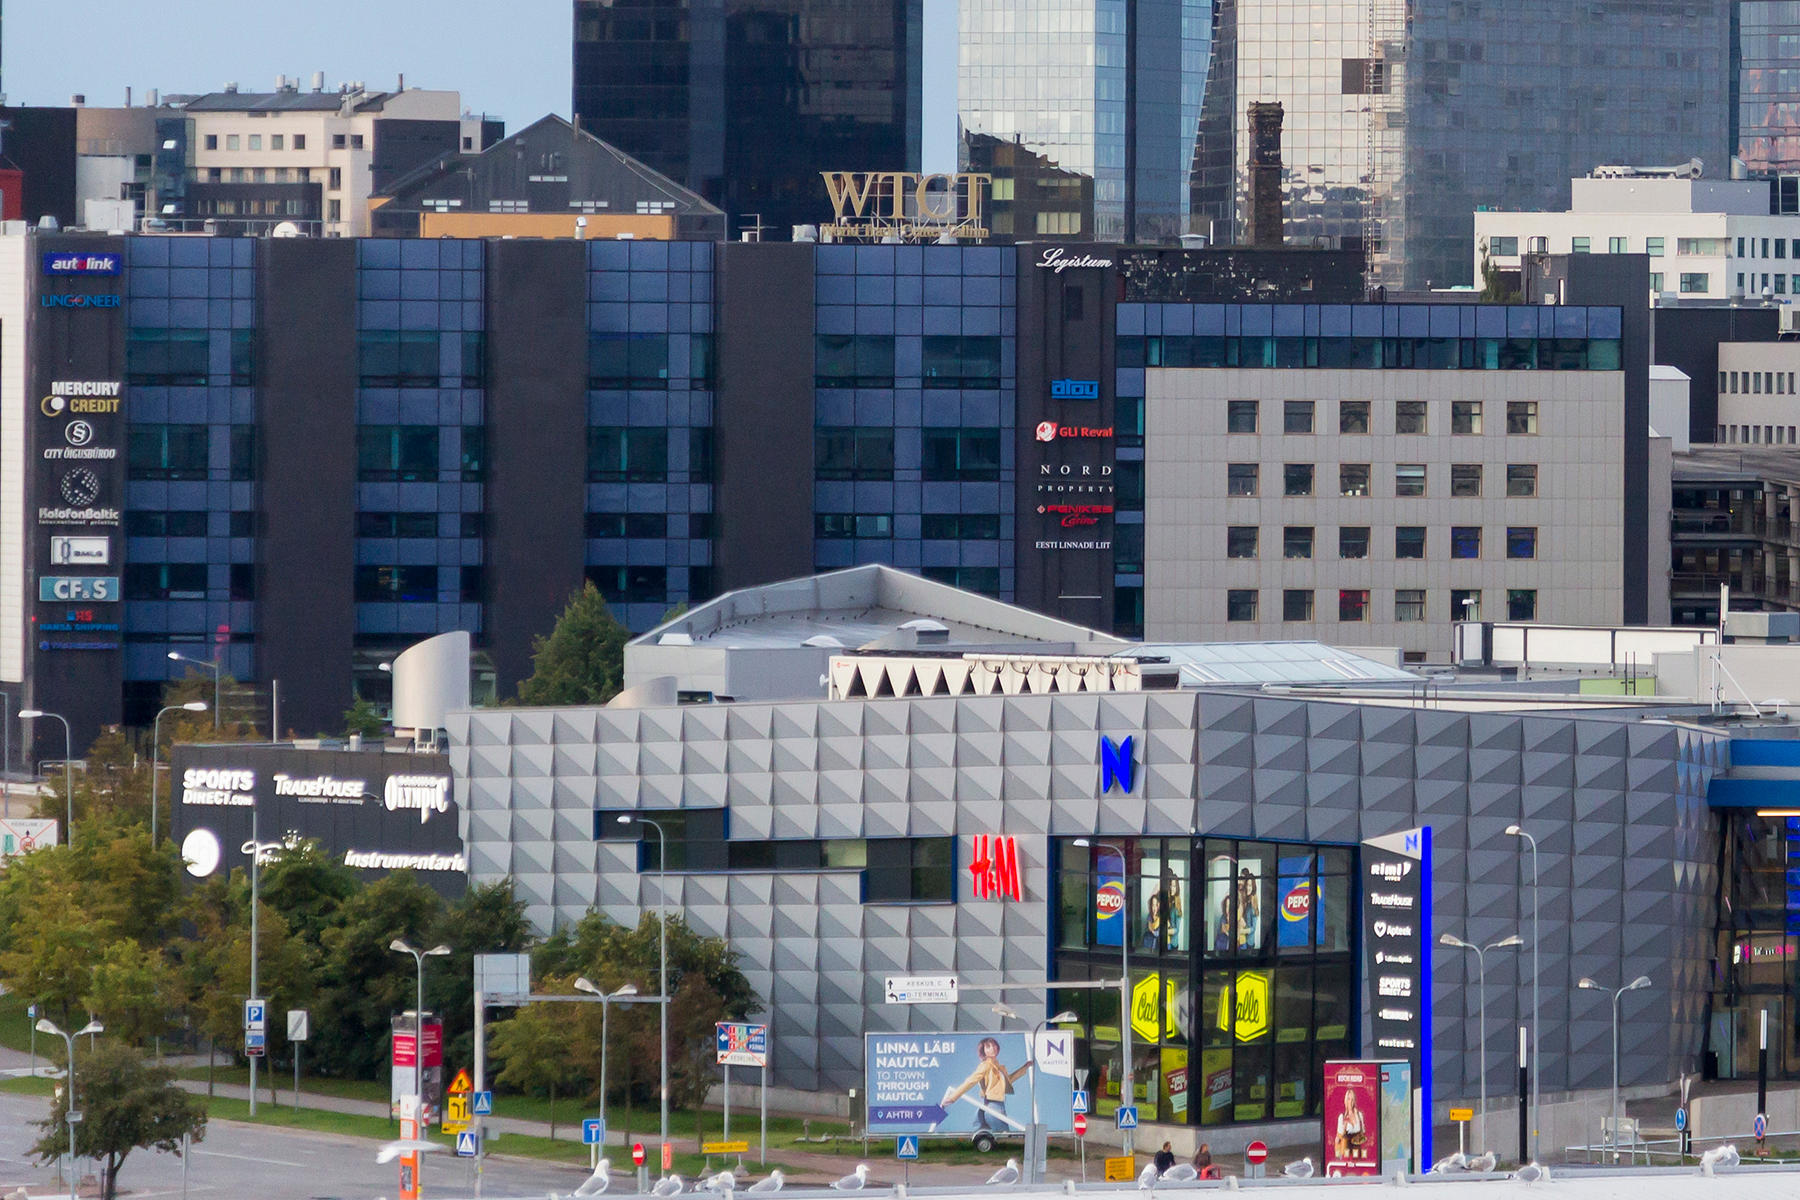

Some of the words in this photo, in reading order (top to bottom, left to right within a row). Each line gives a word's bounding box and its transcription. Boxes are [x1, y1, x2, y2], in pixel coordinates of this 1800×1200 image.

[819, 171, 992, 219] WTCT
[51, 257, 114, 270] autolink
[1035, 248, 1113, 273] Legistum
[51, 382, 120, 395] MERCURY
[70, 399, 120, 412] CREDIT
[44, 449, 64, 459] CITY
[1040, 464, 1112, 475] NORD
[1037, 485, 1114, 494] PROPERTY
[1036, 542, 1058, 550] EESTI
[1059, 542, 1095, 550] LINNADE
[1096, 542, 1111, 550] LIIT
[53, 580, 108, 599] CF&S
[1101, 735, 1133, 794] N
[182, 769, 255, 791] SPORTS
[969, 834, 1022, 903] H&M
[1379, 977, 1411, 989] SPORTS
[876, 1042, 920, 1055] LINNA
[924, 1040, 955, 1054] LÄBI
[876, 1056, 939, 1068] NAUTICA
[877, 1071, 892, 1080] TO
[894, 1071, 925, 1080] TOWN
[876, 1081, 929, 1090] THROUGH
[876, 1092, 924, 1101] NAUTICA
[885, 1111, 913, 1119] AHTRI
[917, 1110, 923, 1119] 9
